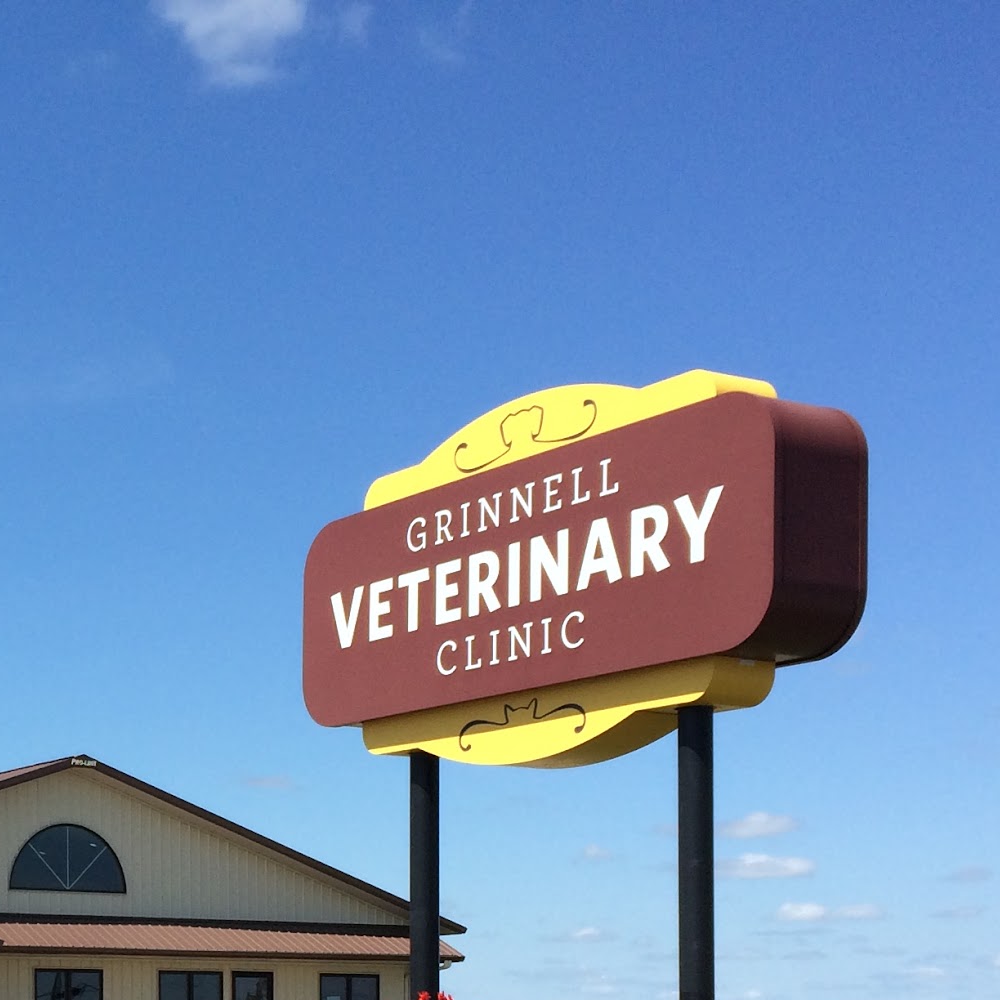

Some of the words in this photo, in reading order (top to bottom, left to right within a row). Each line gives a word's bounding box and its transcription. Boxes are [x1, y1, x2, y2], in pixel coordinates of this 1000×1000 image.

[406, 458, 620, 553] GRINNELL
[330, 484, 724, 649] VETERINARY
[436, 610, 586, 676] CLINIC
